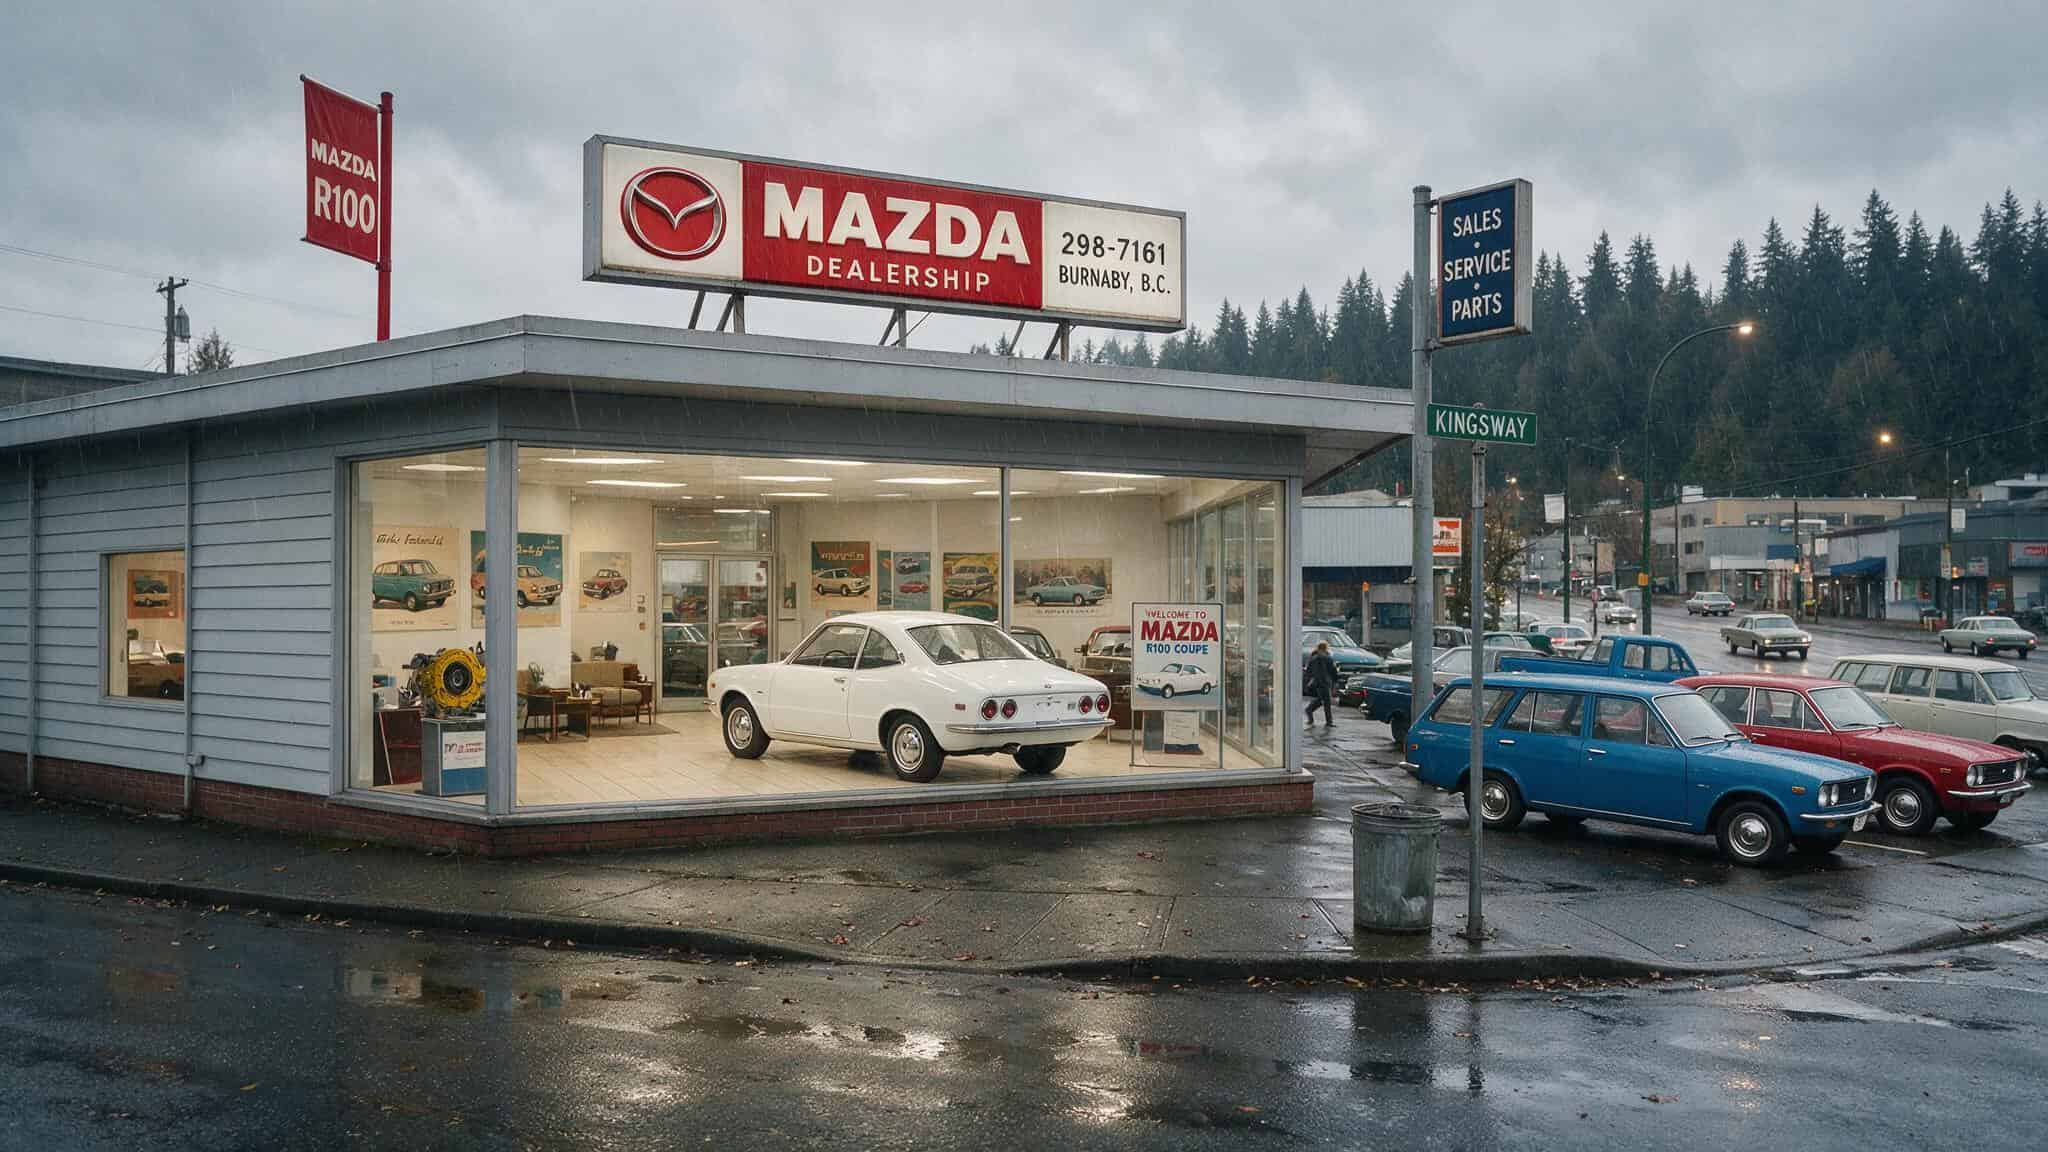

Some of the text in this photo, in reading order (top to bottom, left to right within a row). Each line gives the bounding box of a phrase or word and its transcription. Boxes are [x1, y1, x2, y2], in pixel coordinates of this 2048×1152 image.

[311, 138, 376, 182] MAZDA
[314, 176, 375, 234] R100
[763, 181, 1031, 265] MAZDA
[1453, 207, 1502, 238] SALES
[1061, 231, 1165, 266] 298-7161
[807, 255, 990, 292] DEALERSHIP
[1058, 264, 1171, 294] BURNABY, B.C.
[1444, 249, 1511, 282] SERVICE
[1452, 293, 1502, 322] PARTS
[1435, 409, 1528, 440] KINGSWAY
[1145, 609, 1207, 619] WELCOME TO
[1140, 620, 1219, 642] MAZDA
[1146, 643, 1209, 654] R100 COUPE
